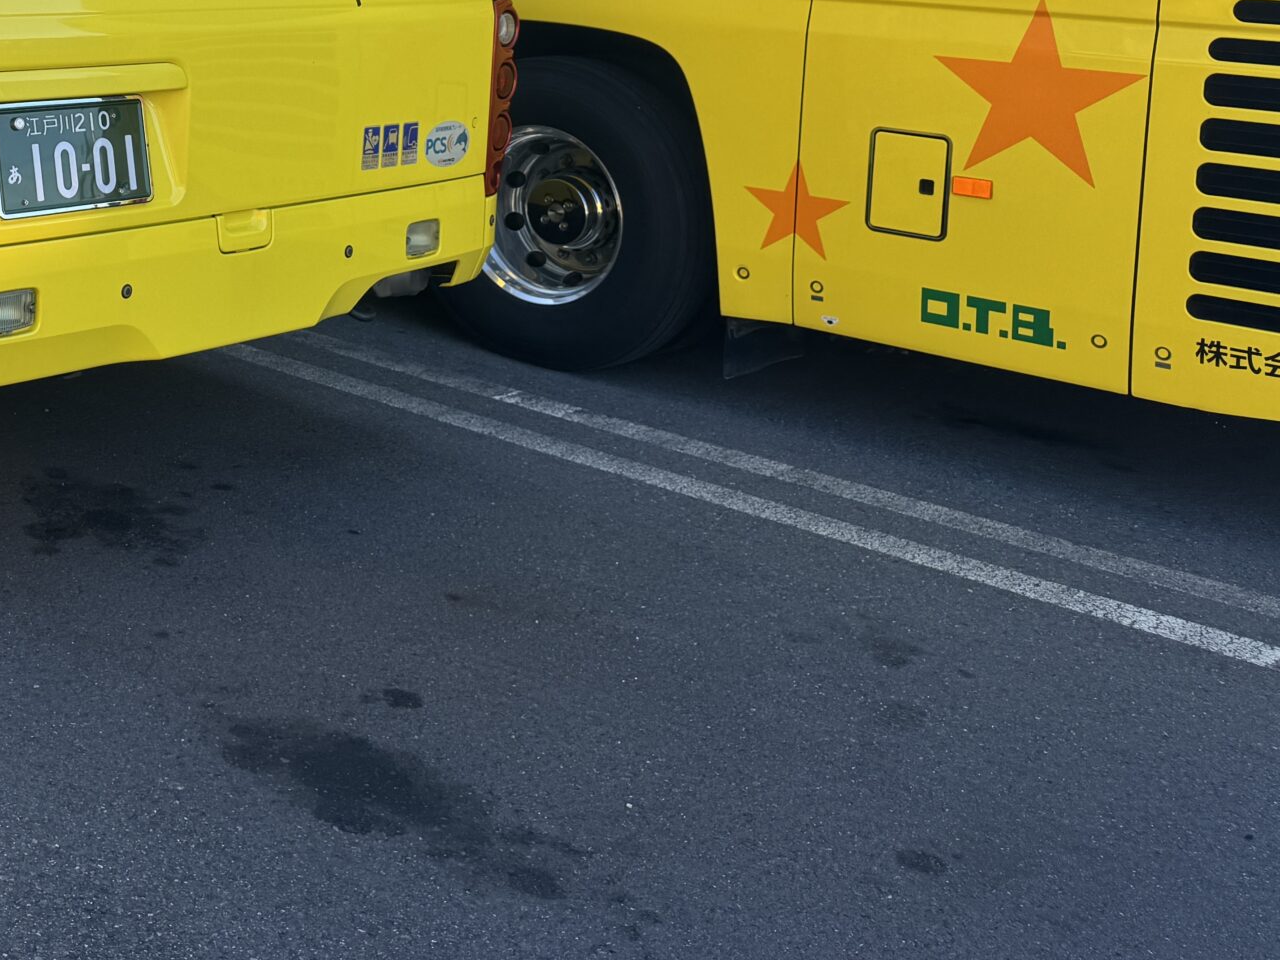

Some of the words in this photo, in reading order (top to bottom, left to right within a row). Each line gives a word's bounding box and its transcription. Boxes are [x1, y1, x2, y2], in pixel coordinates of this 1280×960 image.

[8, 165, 22, 185] あ
[31, 134, 138, 202] 10-01
[425, 136, 447, 155] PCS
[921, 287, 1067, 350] O.T.B.
